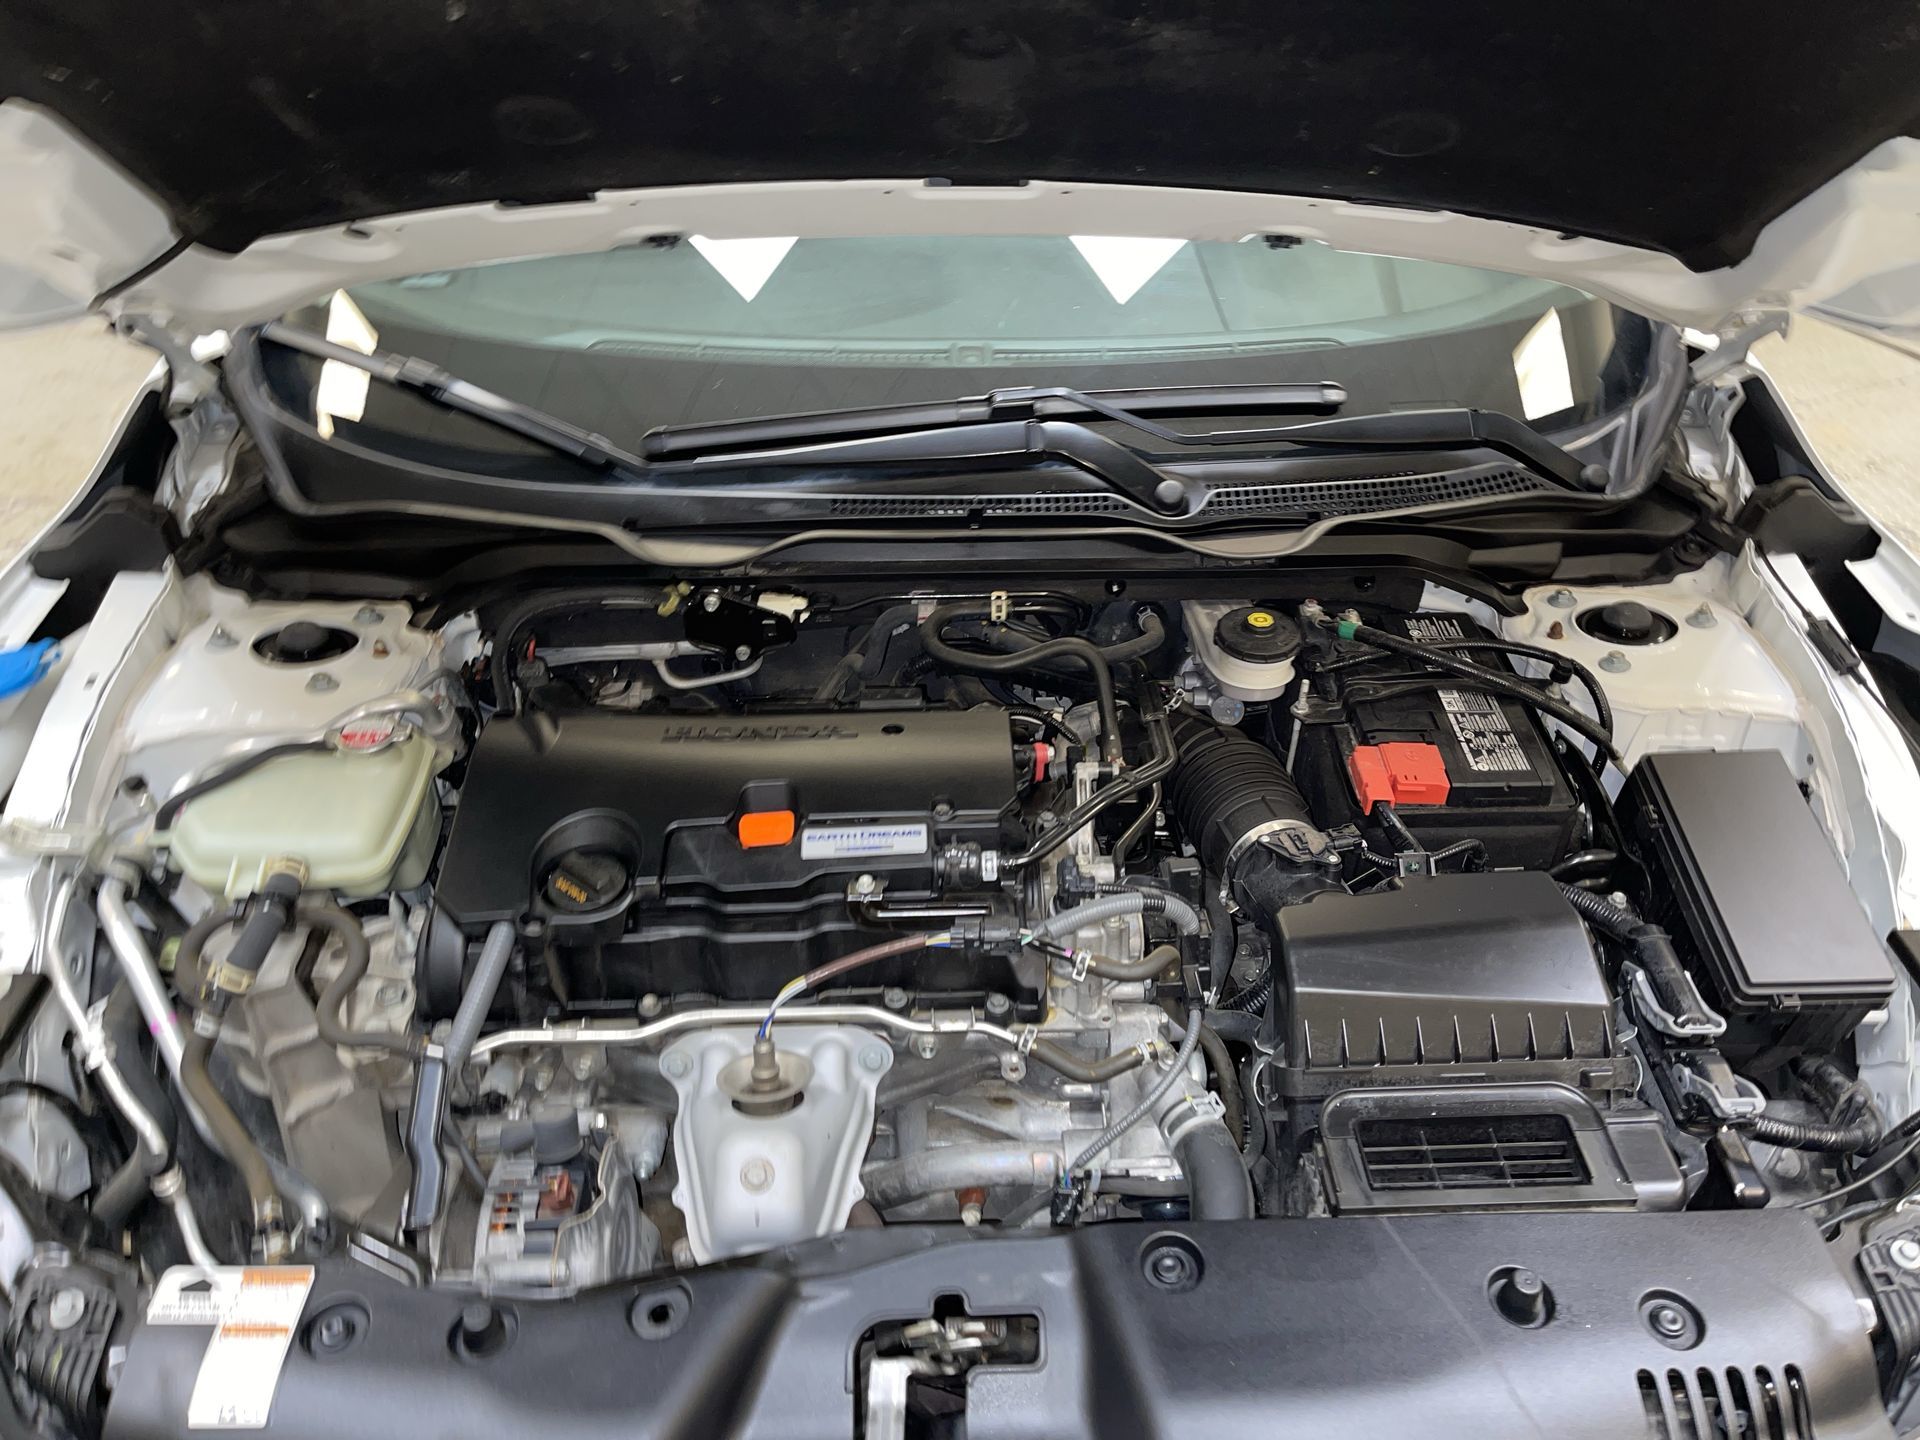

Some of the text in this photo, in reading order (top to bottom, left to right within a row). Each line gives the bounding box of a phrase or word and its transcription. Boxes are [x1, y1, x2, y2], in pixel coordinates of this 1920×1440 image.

[662, 726, 859, 743] HONDA
[806, 829, 922, 842] EARTH DREAMS
